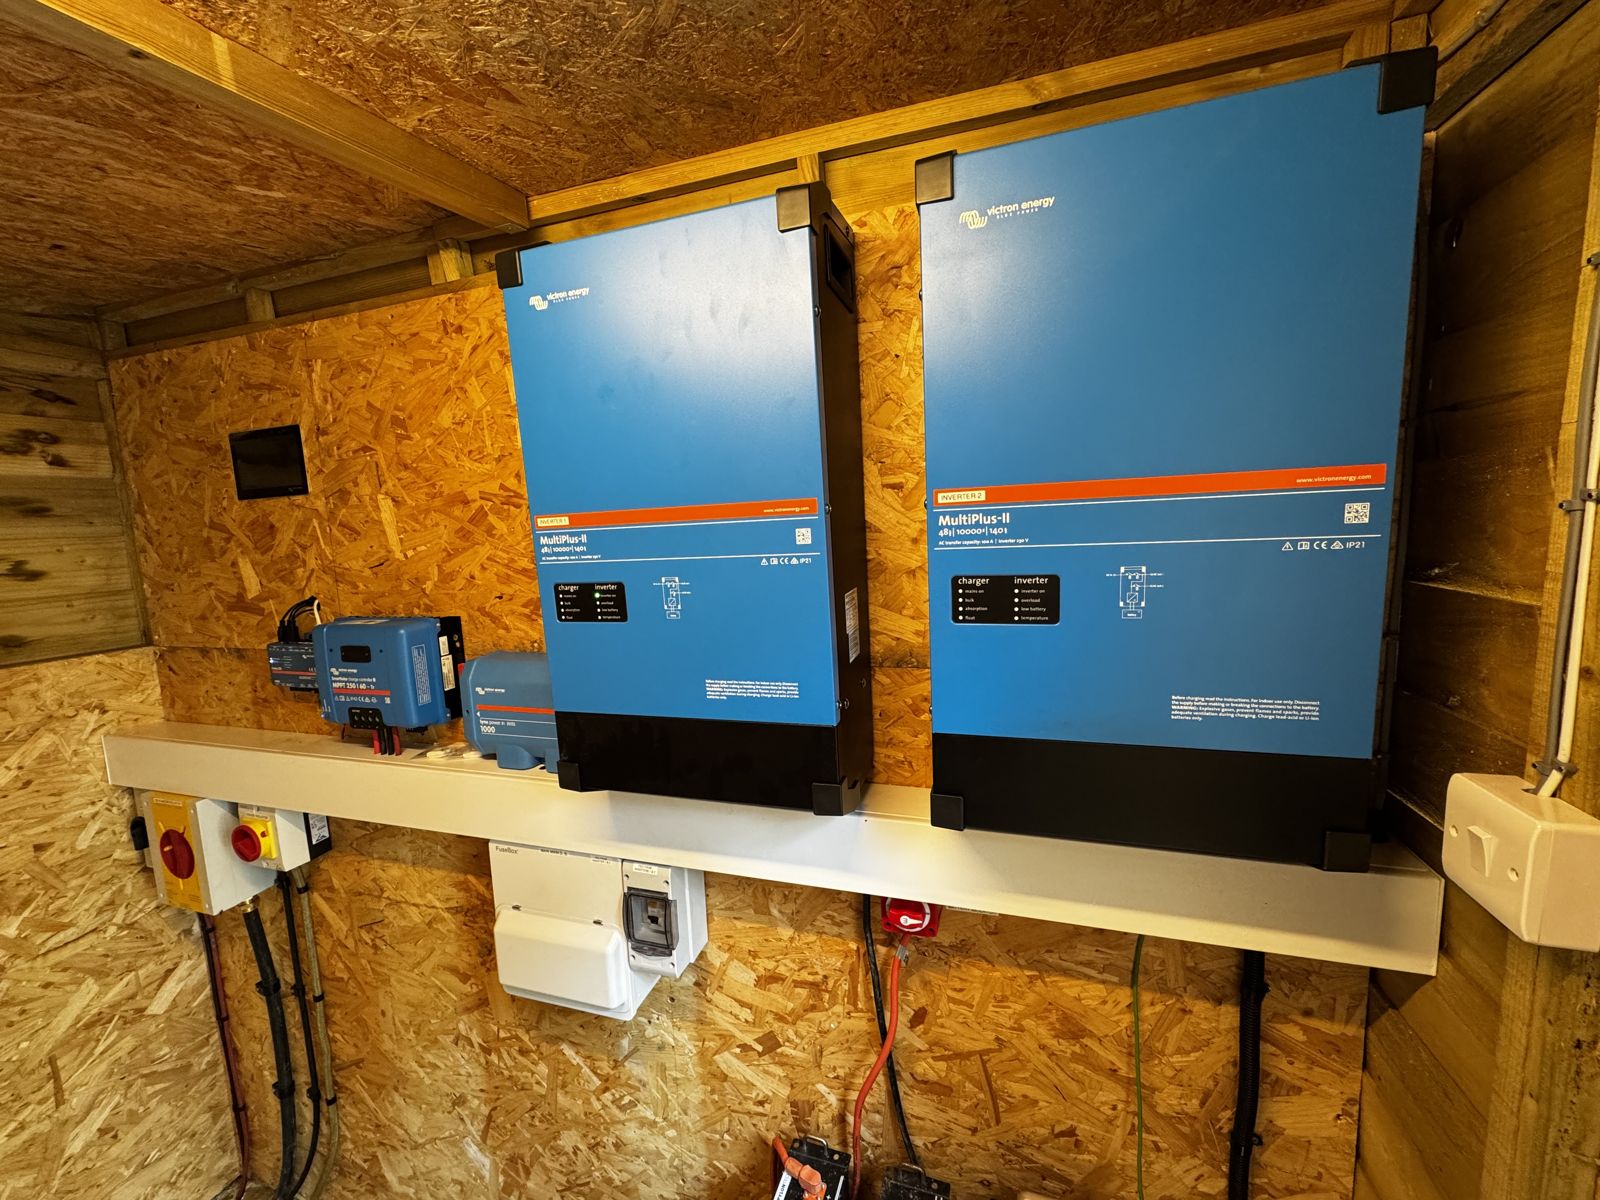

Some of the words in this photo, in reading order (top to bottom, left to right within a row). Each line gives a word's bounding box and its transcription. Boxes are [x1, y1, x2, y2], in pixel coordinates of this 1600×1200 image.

[986, 203, 1018, 216] victron
[1020, 196, 1055, 208] energy
[940, 492, 976, 502] INVERTER
[977, 492, 982, 500] 2
[938, 512, 1010, 526] MultiPlus-II
[540, 533, 588, 546] MultiPlus-II
[1346, 541, 1366, 549] IP21
[957, 577, 990, 587] charger
[1014, 576, 1049, 585] inverter
[558, 584, 580, 593] charger
[594, 583, 618, 591] inverter
[480, 725, 496, 734] 1000
